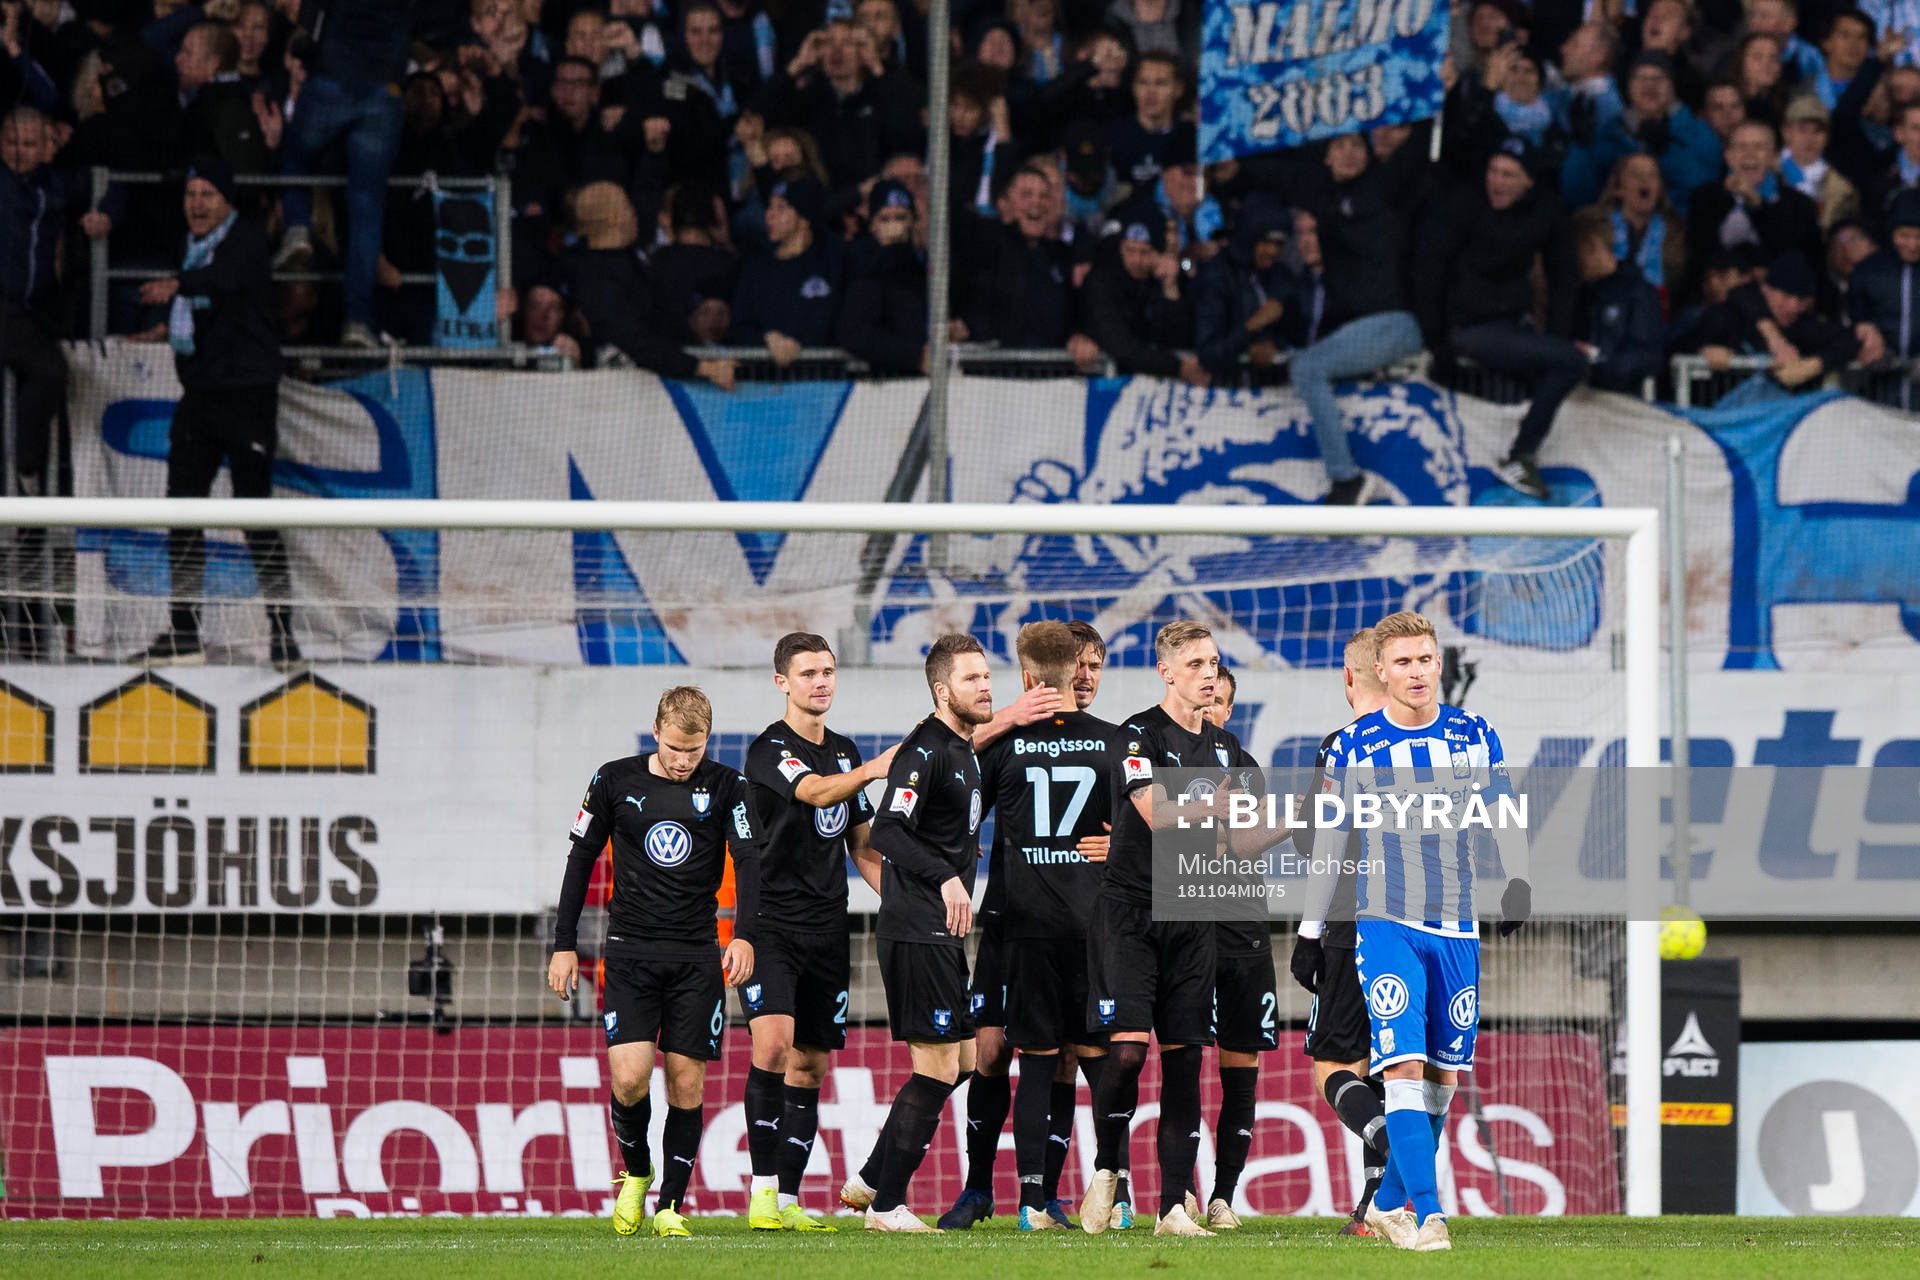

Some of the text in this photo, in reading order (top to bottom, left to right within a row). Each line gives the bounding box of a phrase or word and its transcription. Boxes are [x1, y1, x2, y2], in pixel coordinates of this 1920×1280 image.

[1250, 64, 1385, 138] 2003
[1014, 738, 1105, 757] Bengtsson
[1025, 766, 1096, 837] 17
[710, 999, 723, 1036] 6
[834, 990, 849, 1024] 2
[1261, 991, 1276, 1028] 2
[1449, 1035, 1464, 1051] 4
[1809, 1110, 1865, 1212] J
